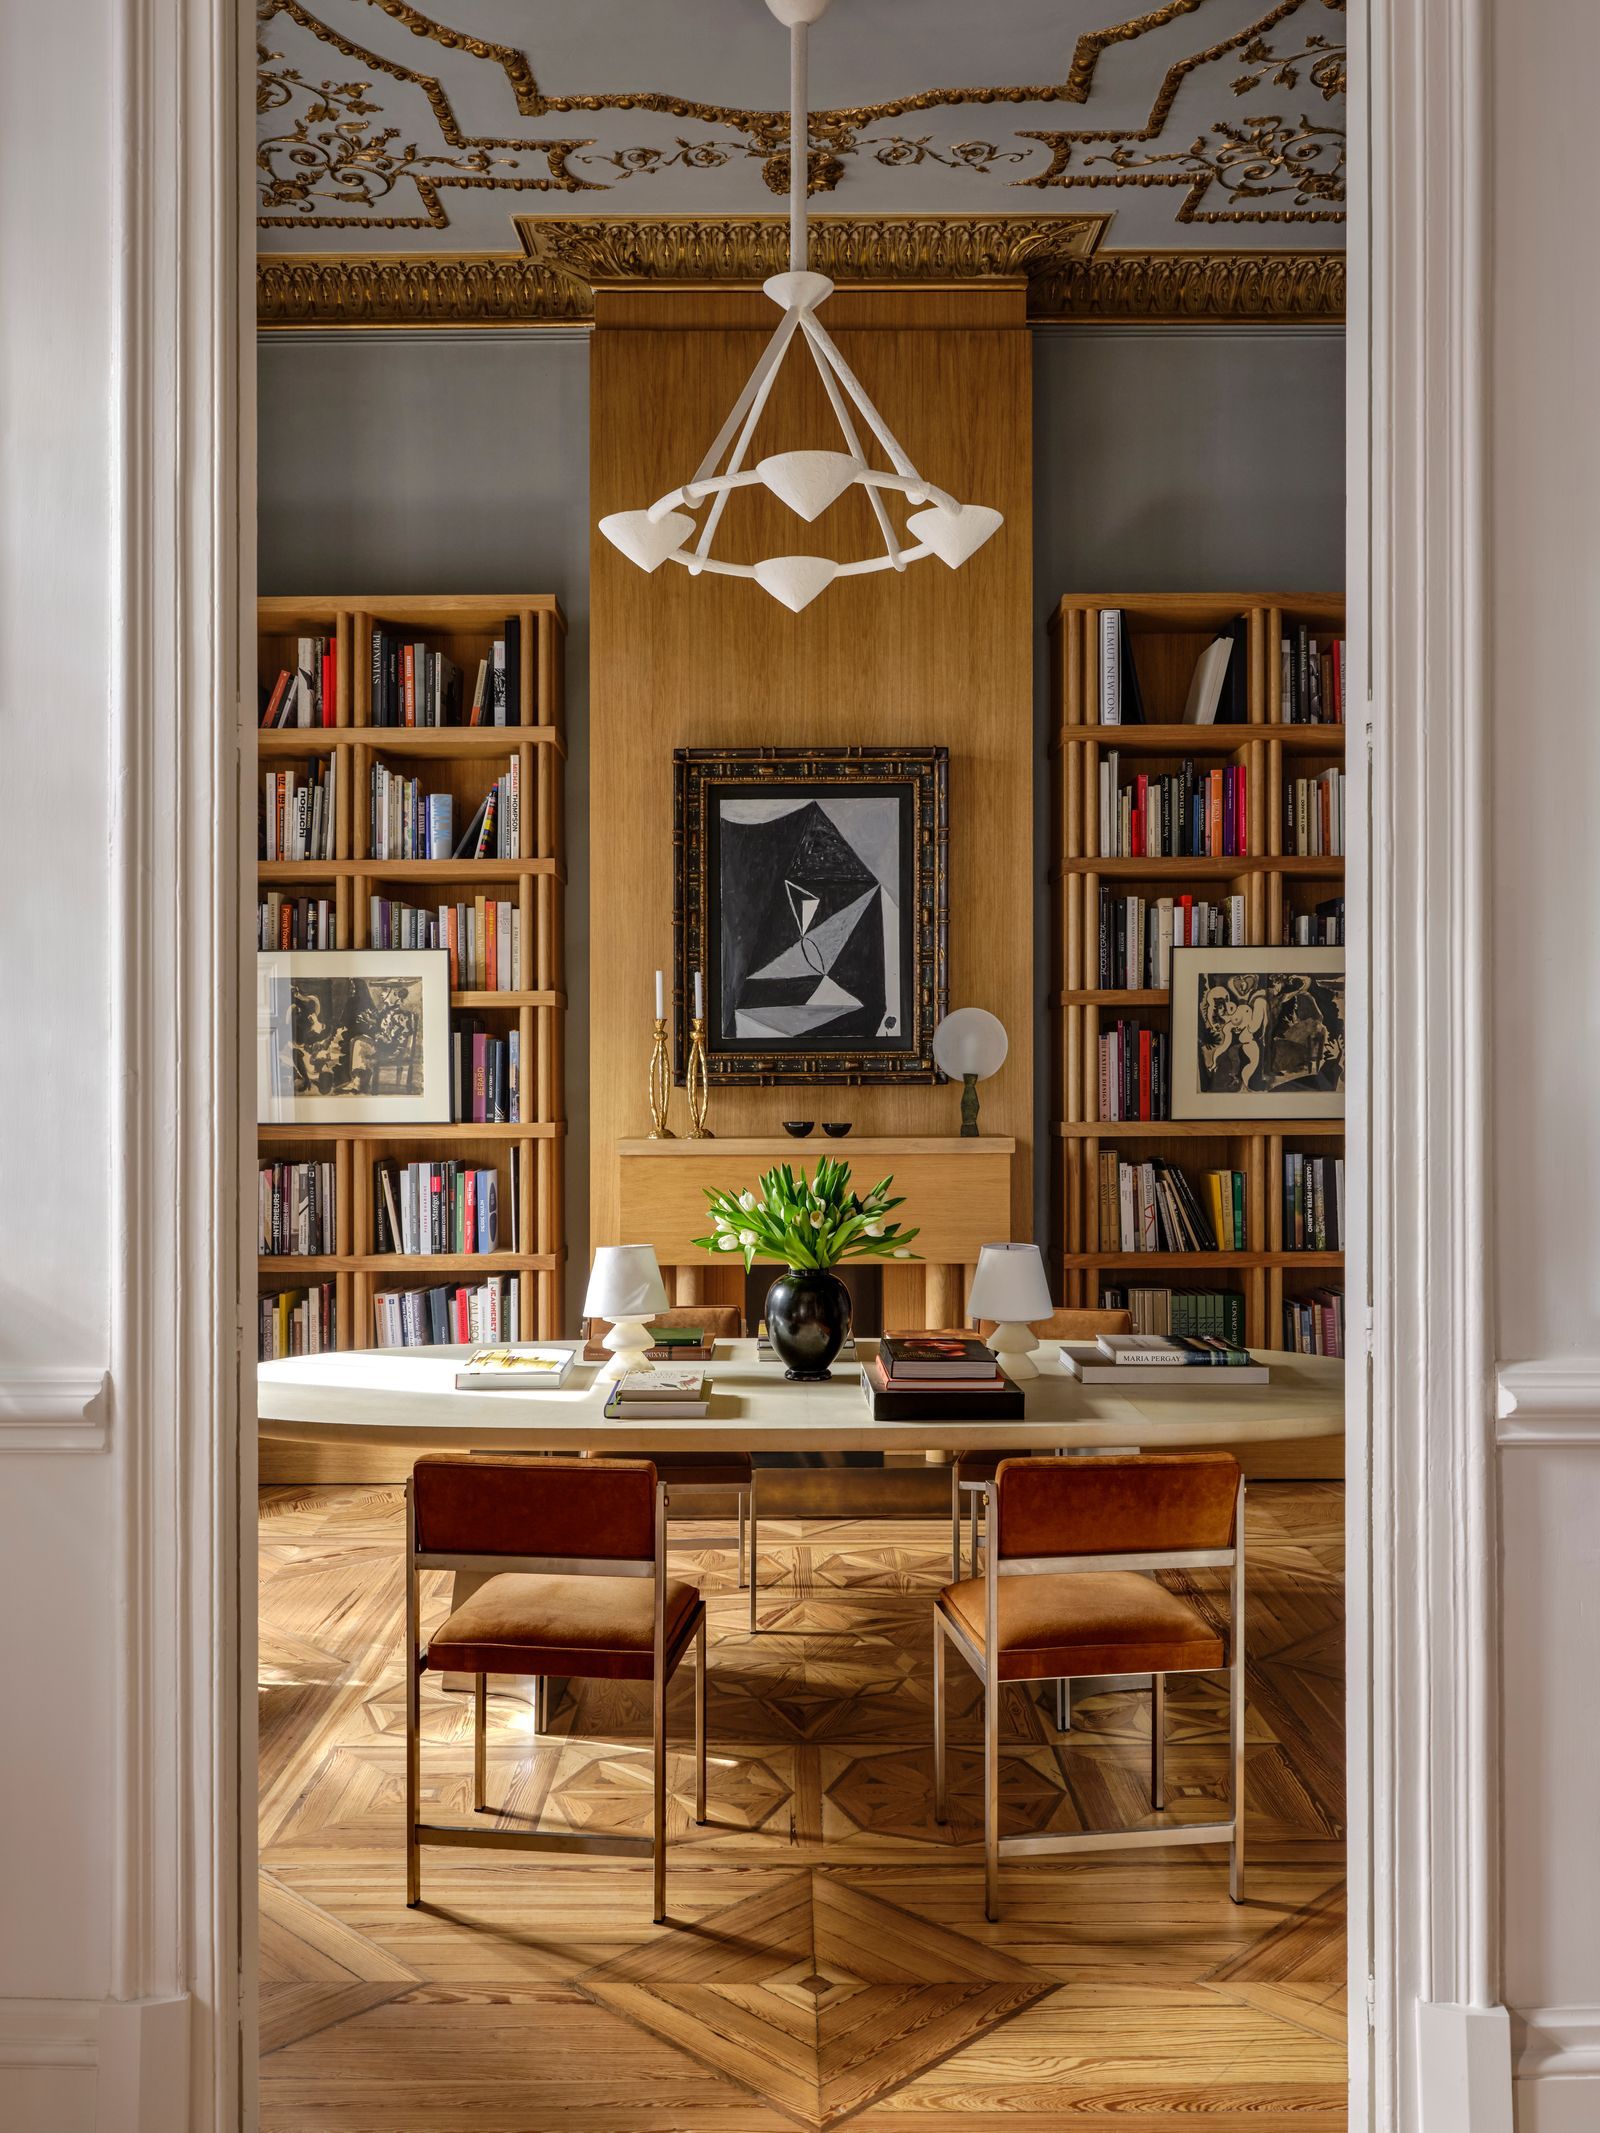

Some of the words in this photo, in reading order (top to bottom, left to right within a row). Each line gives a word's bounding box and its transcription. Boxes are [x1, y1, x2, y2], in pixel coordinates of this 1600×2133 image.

[373, 634, 381, 685] PRONOVIAS
[1106, 616, 1115, 662] HELMUT
[1106, 666, 1115, 715] NEWTON
[299, 790, 307, 838] noguchi
[282, 908, 290, 928] Pierre
[272, 1193, 280, 1238] INTÉRIEURS
